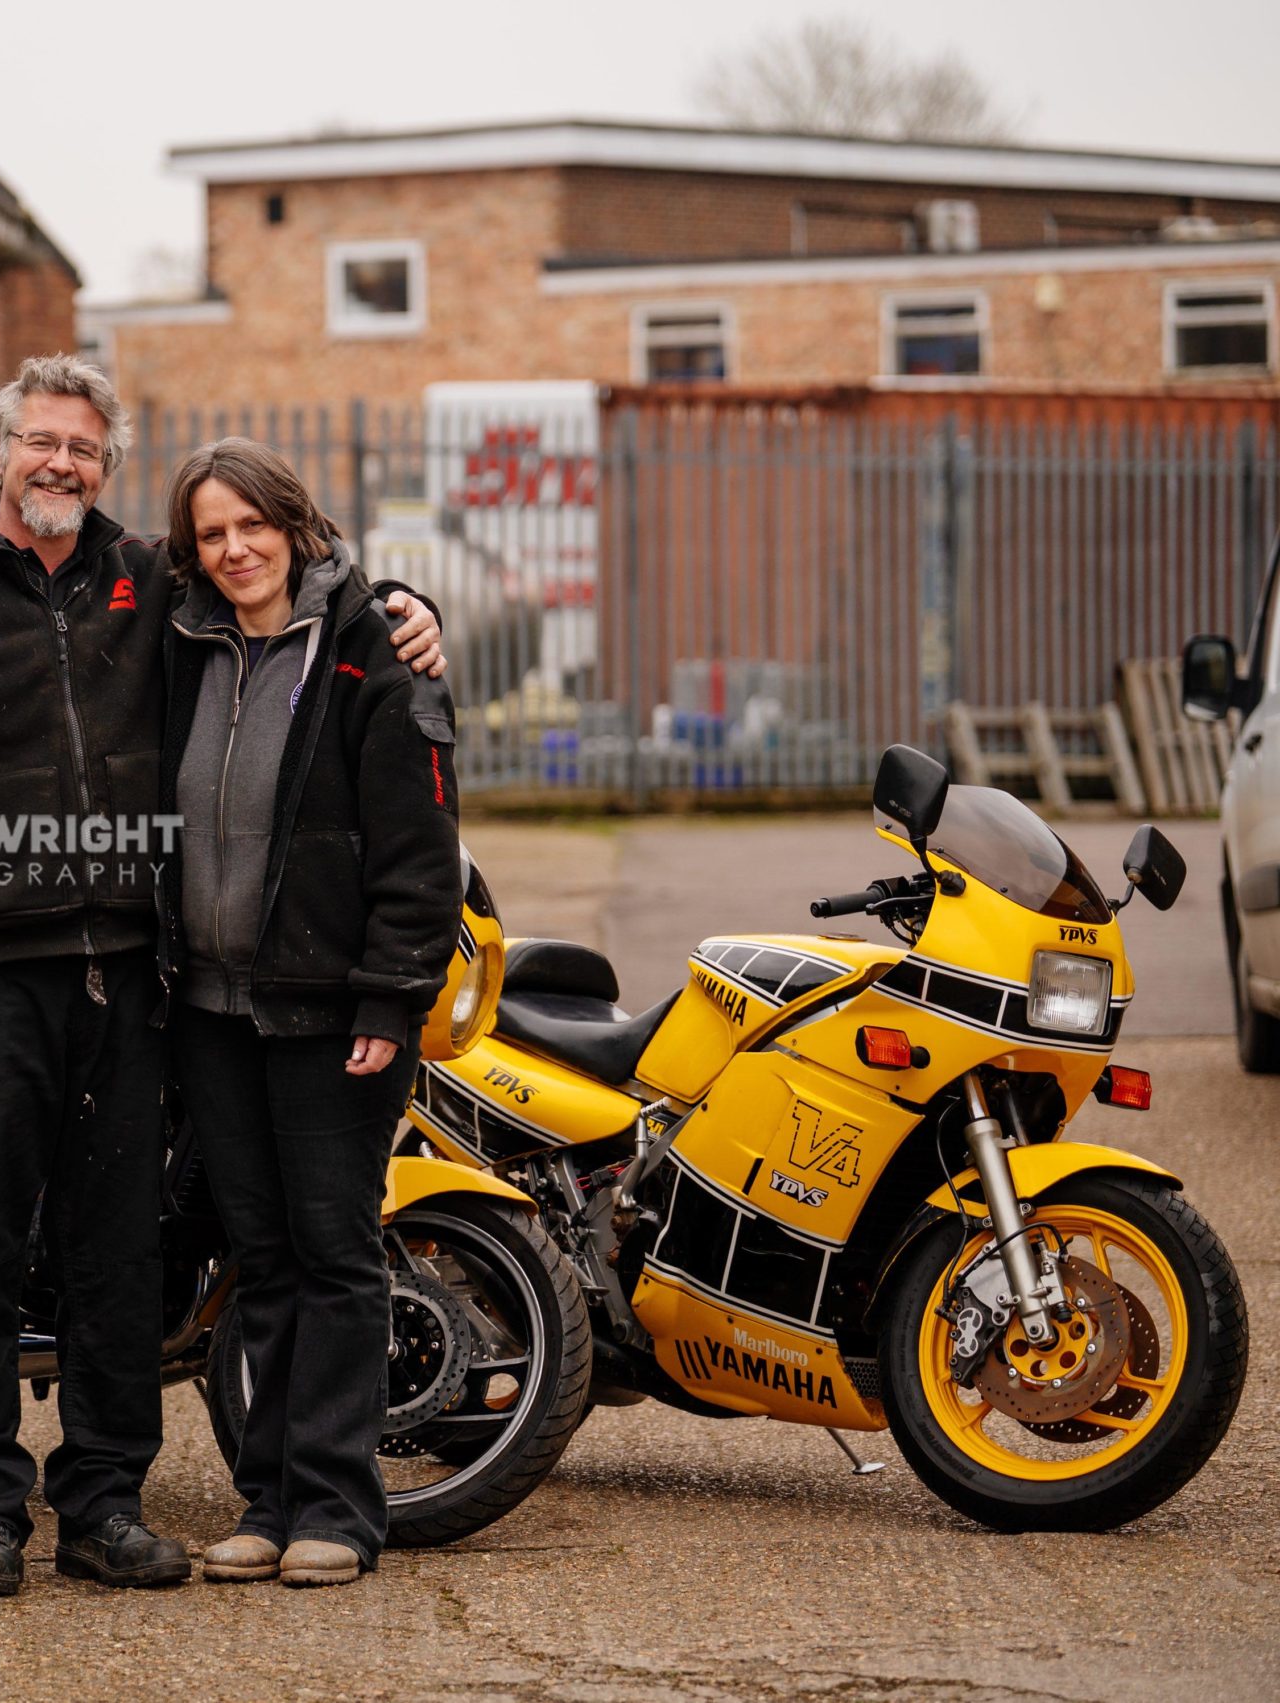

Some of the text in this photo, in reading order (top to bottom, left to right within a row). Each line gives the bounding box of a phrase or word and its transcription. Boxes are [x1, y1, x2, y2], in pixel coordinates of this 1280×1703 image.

[1059, 925, 1098, 945] YPVS
[696, 970, 748, 1027] YAMAHA
[483, 1065, 541, 1104] YPVS
[769, 1169, 829, 1208] YPVS
[733, 1327, 809, 1367] Marlboro
[704, 1335, 838, 1409] YAMAHA
